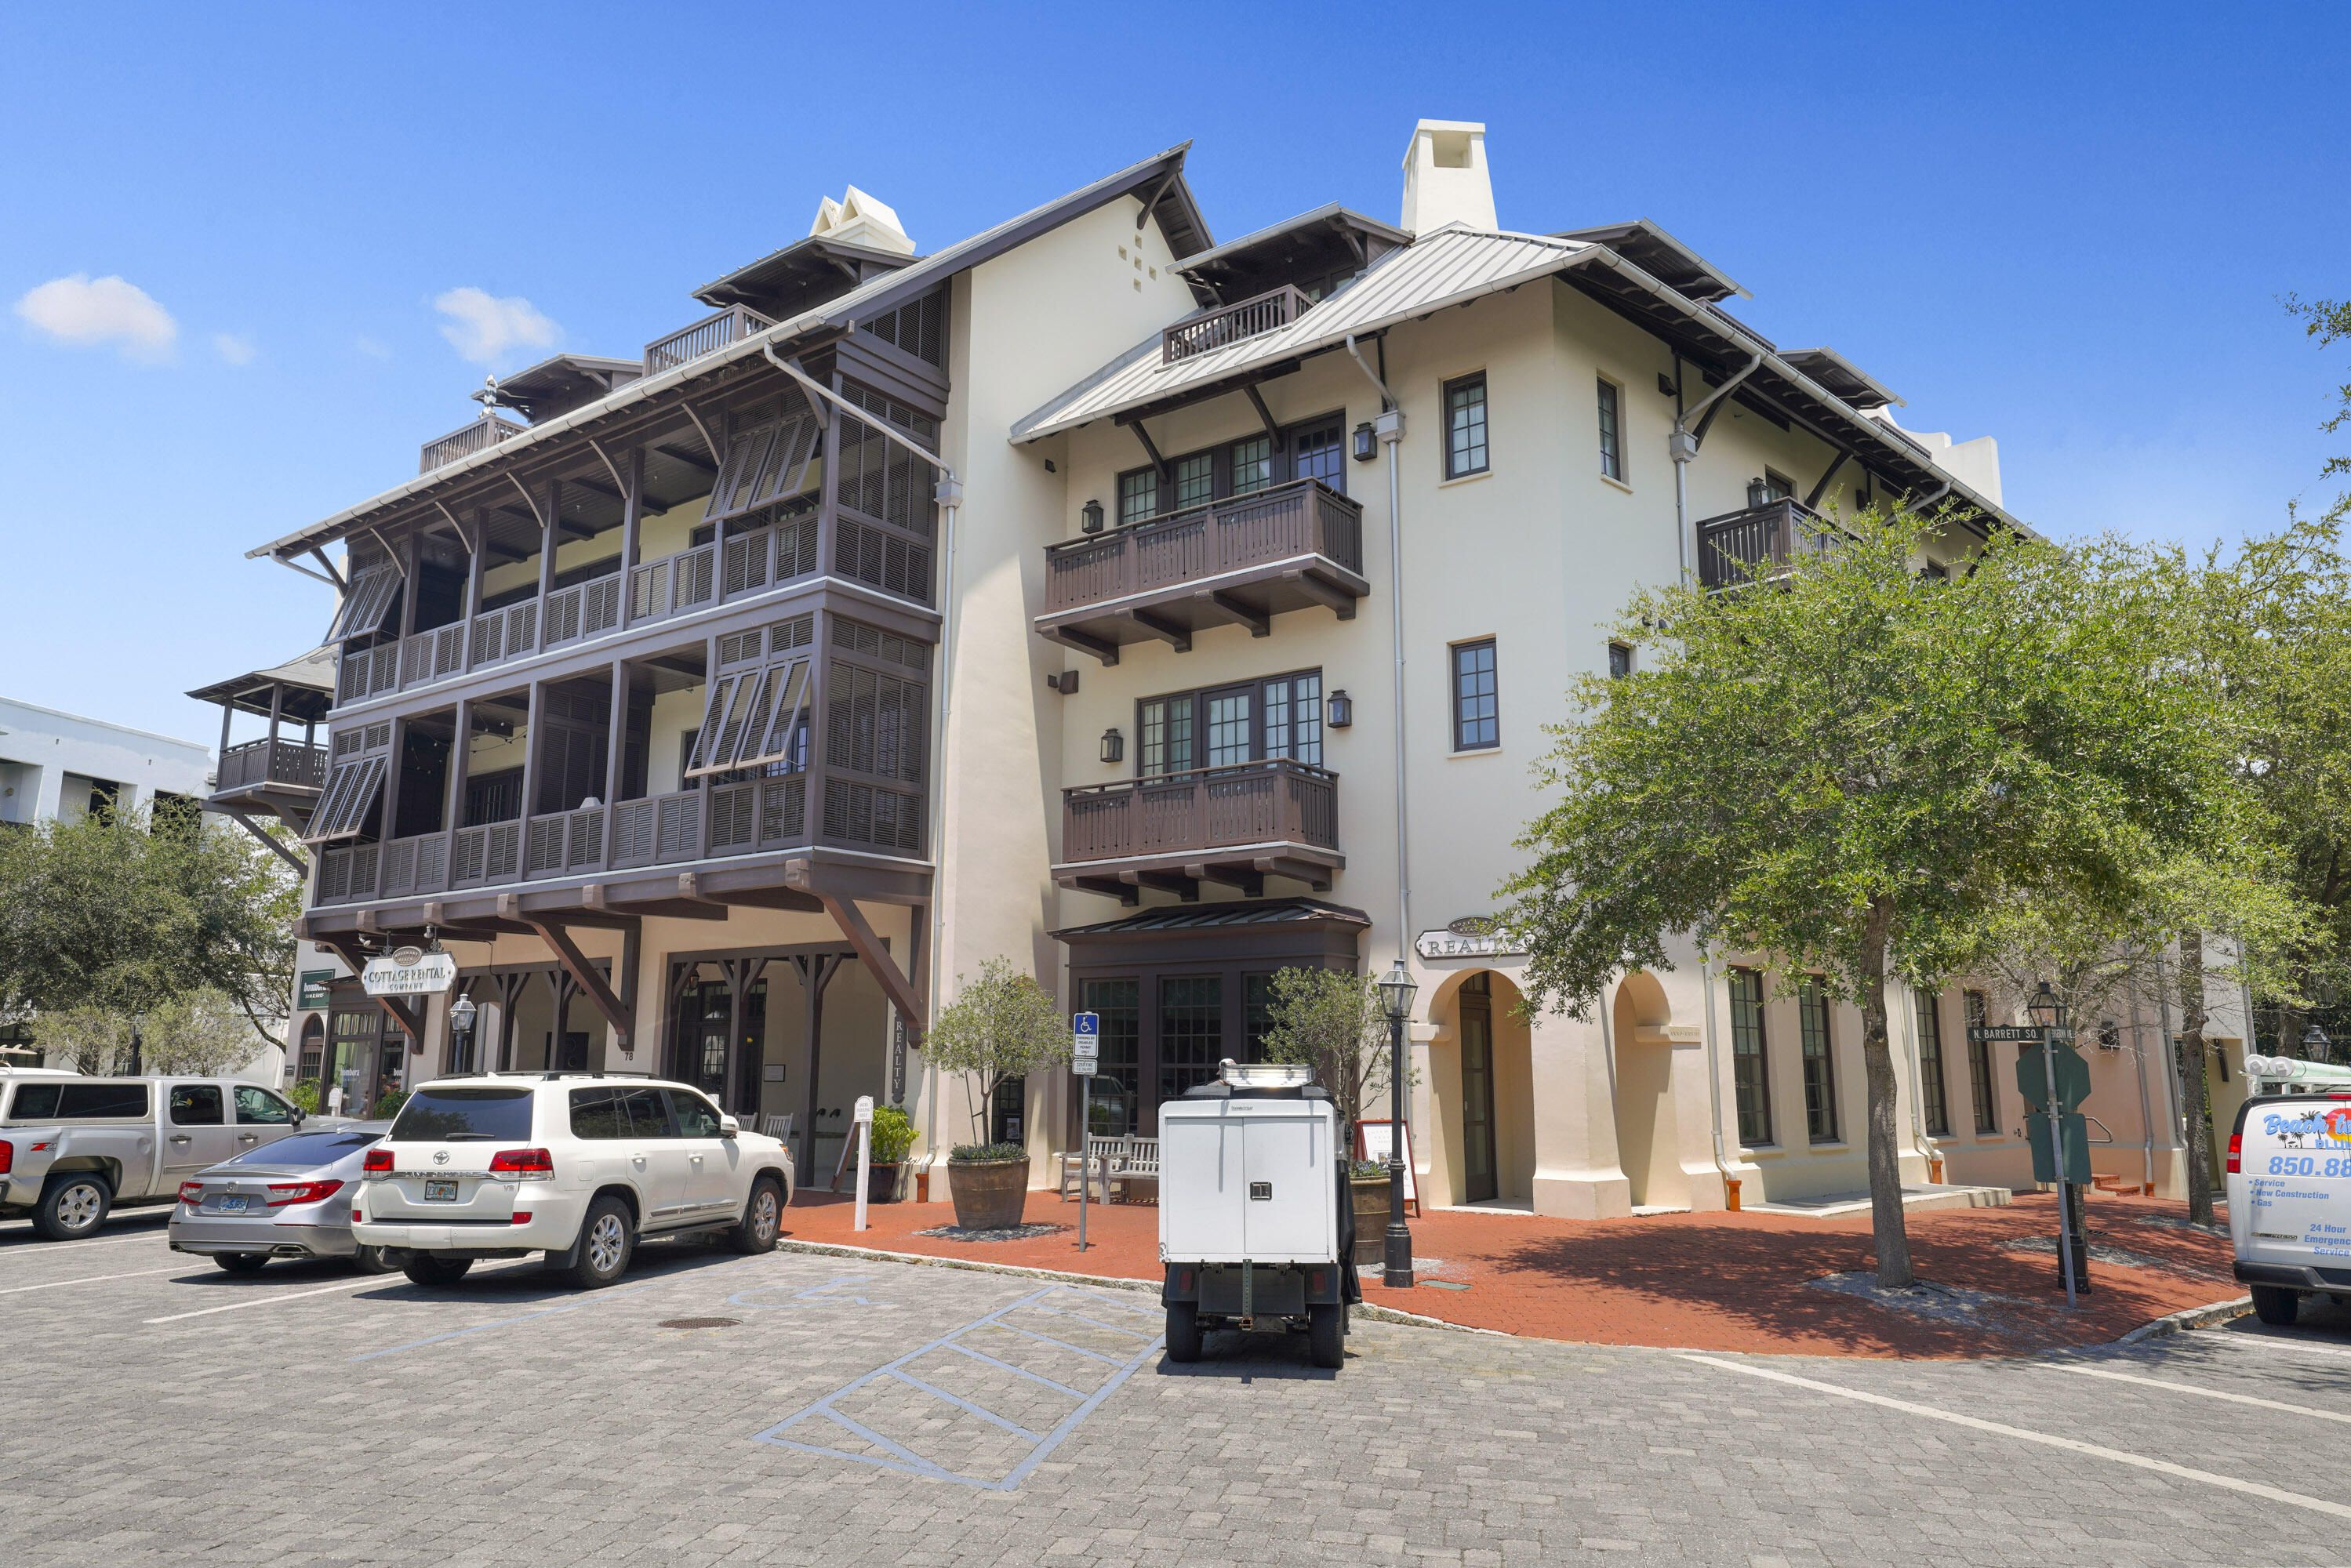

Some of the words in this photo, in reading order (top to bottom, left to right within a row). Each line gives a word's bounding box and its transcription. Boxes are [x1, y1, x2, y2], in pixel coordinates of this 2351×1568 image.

[369, 968, 409, 982] COTTAGE
[411, 967, 445, 980] RENTAL
[390, 982, 424, 991] COMPANY
[1984, 1029, 2020, 1039] BARRETT
[2025, 1029, 2038, 1039] SQ.
[625, 1052, 634, 1061] 78
[894, 1021, 903, 1089] REALTY
[2263, 1113, 2329, 1135] Beach
[2255, 1178, 2285, 1188] Service
[2255, 1189, 2273, 1197] New
[2275, 1189, 2329, 1200] Construction
[2310, 1223, 2321, 1232] 24
[2324, 1225, 2346, 1233] Hour
[2313, 1246, 2349, 1257] Service
